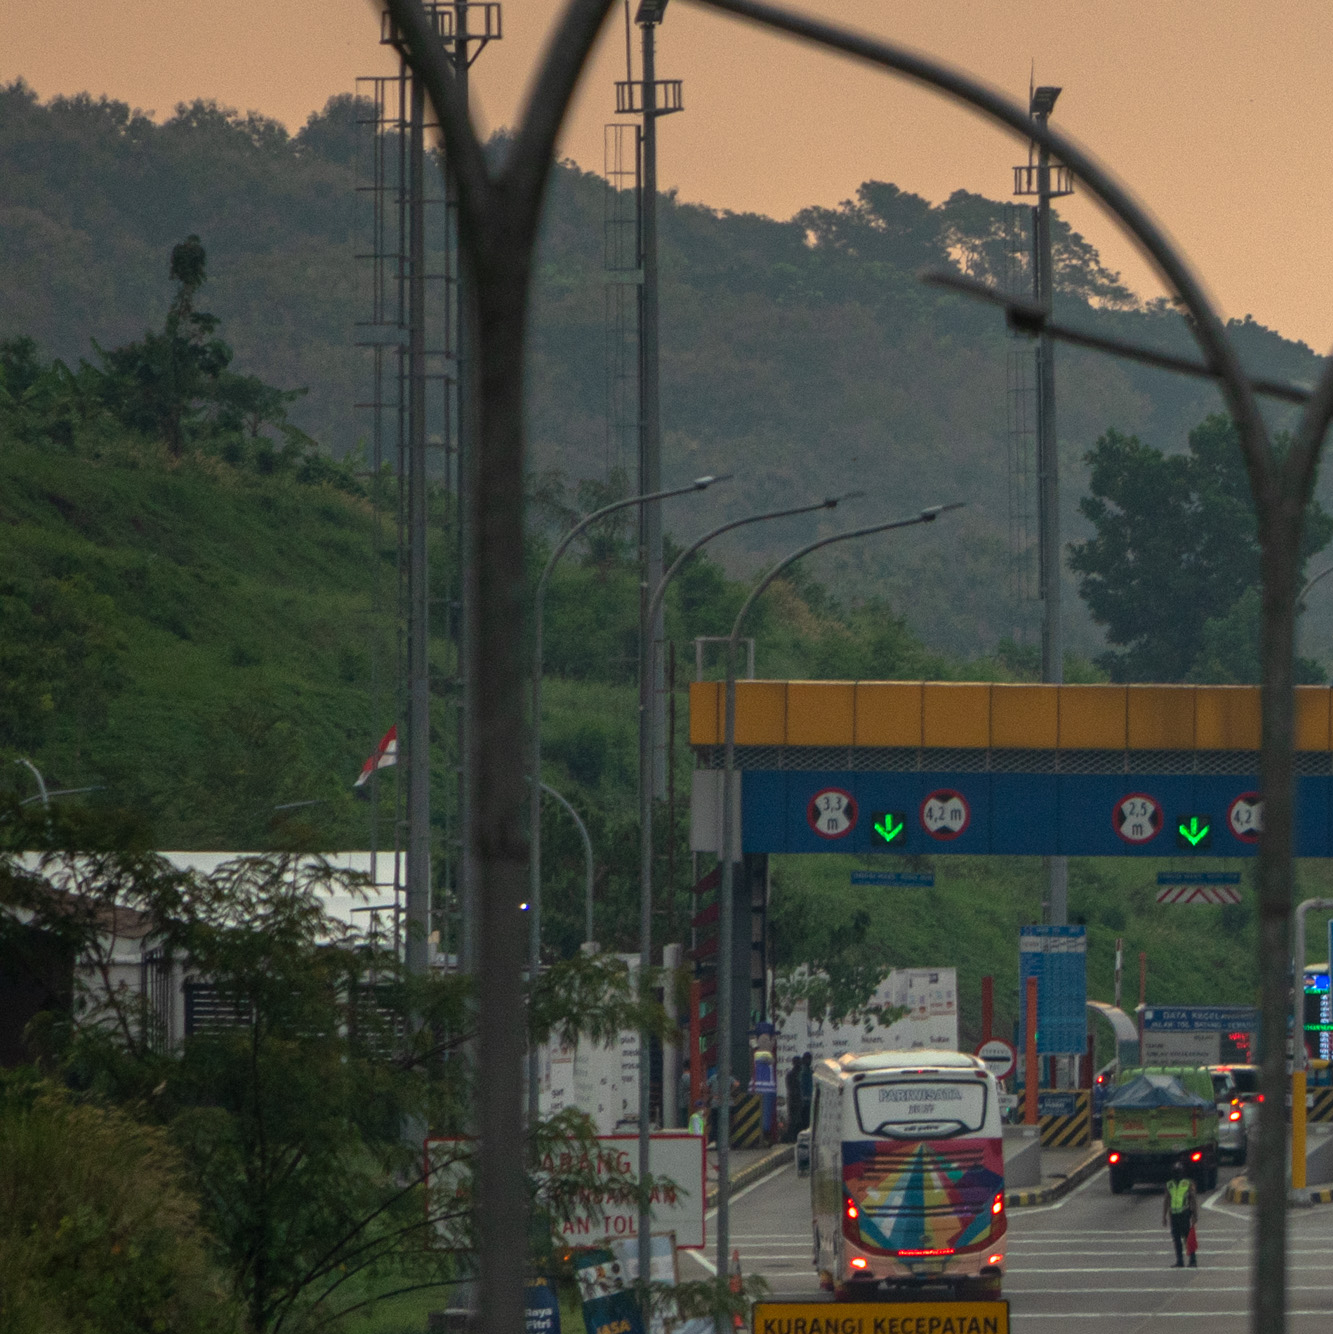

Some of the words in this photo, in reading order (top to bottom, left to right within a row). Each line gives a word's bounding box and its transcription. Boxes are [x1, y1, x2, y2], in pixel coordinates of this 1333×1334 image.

[823, 797, 843, 812] 3,3
[1129, 802, 1148, 819] 2,5
[926, 806, 946, 824] 4,2
[950, 807, 962, 820] m
[1234, 810, 1253, 829] 4,2
[827, 818, 838, 831] m
[1132, 823, 1144, 836] m
[879, 1088, 962, 1102] PARIWISATA
[604, 1215, 637, 1234] TOL
[873, 1317, 998, 1334] KECEPATAN
